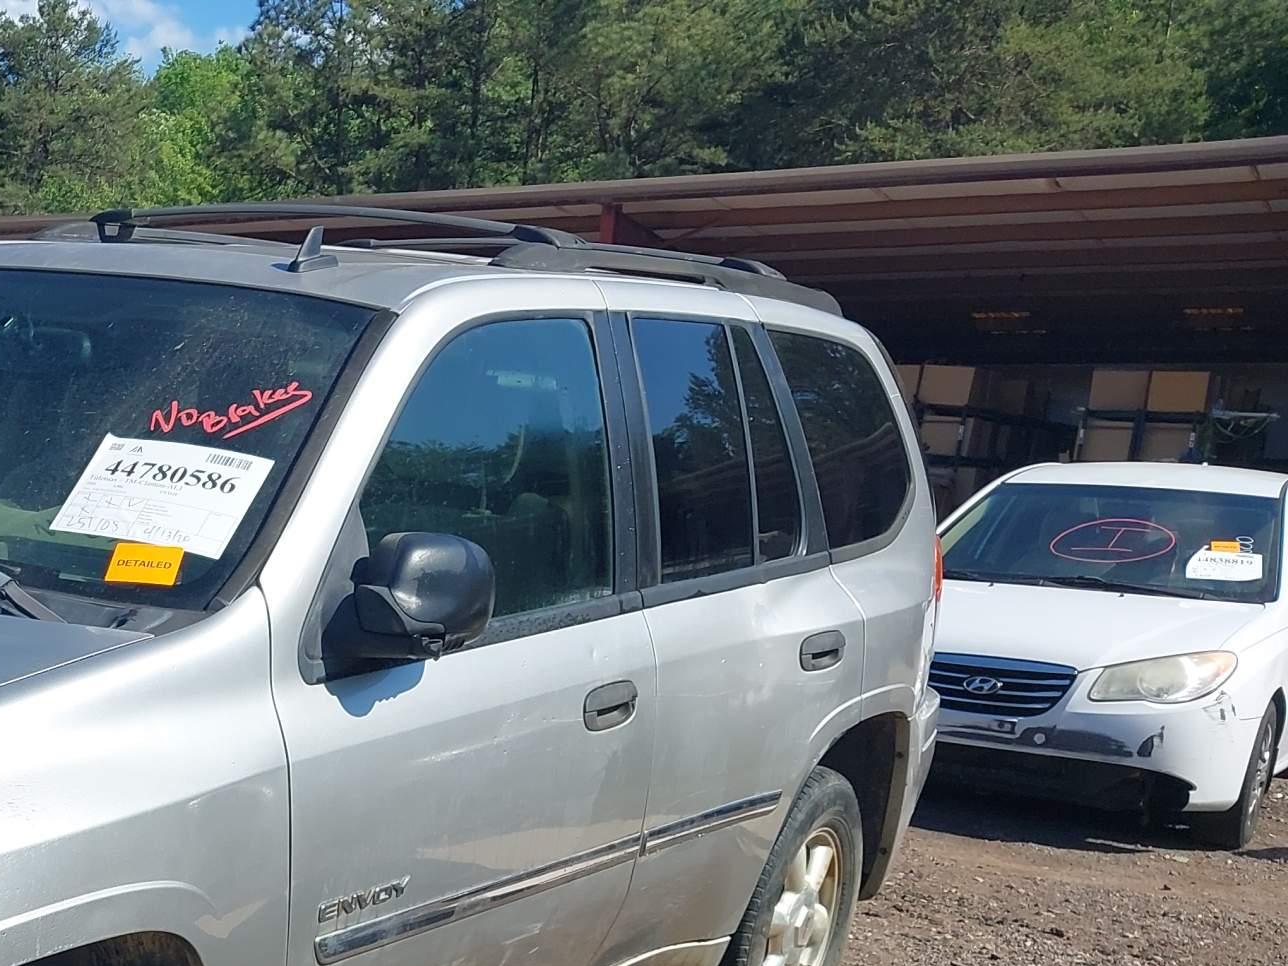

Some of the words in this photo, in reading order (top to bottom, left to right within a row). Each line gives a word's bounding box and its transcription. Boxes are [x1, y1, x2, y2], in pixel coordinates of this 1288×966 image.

[105, 459, 240, 494] 44780586
[116, 559, 173, 570] DETAILED
[317, 874, 411, 923] ENVOY
